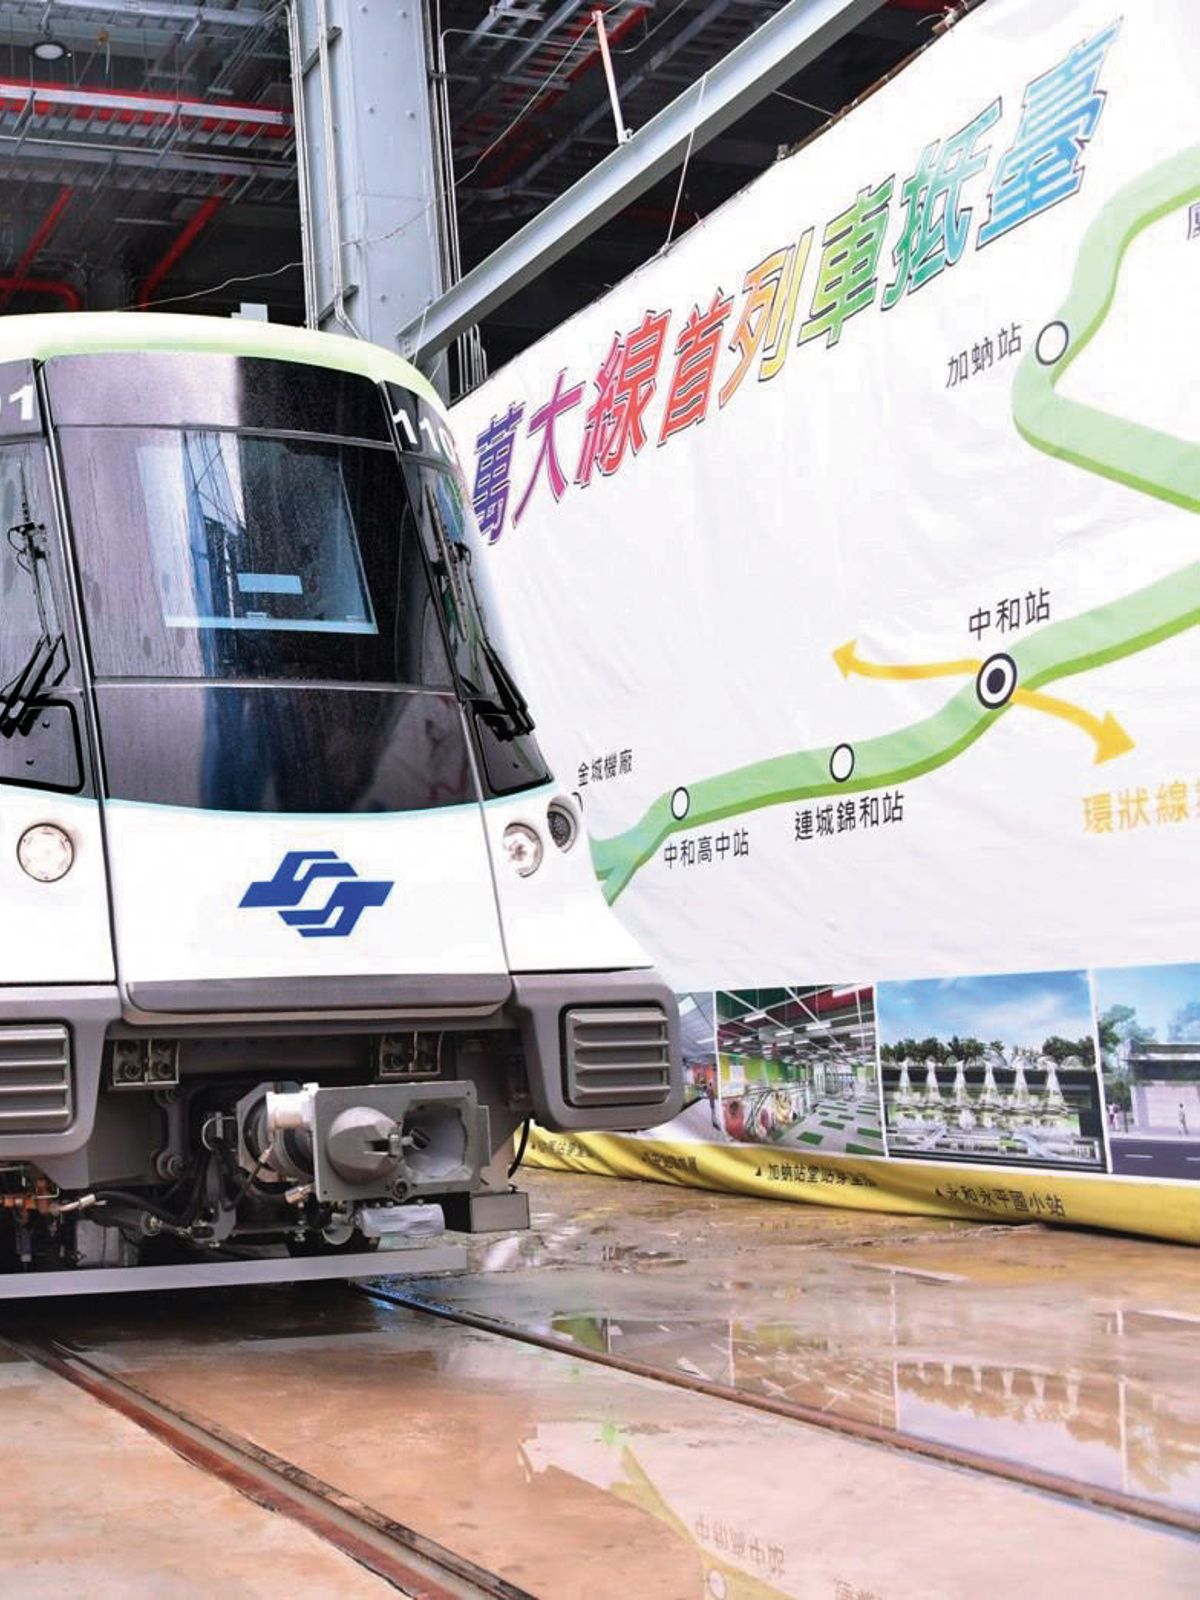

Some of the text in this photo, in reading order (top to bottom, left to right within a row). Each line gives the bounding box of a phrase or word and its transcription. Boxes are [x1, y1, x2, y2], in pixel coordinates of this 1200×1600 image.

[472, 15, 1124, 545] 萬大線首列車抵臺
[945, 321, 1022, 388] 加蚋站
[968, 587, 1050, 641] 中和站
[794, 790, 904, 842] 連城錦和站
[1082, 779, 1200, 833] 環狀線
[663, 828, 749, 869] 中和高中站
